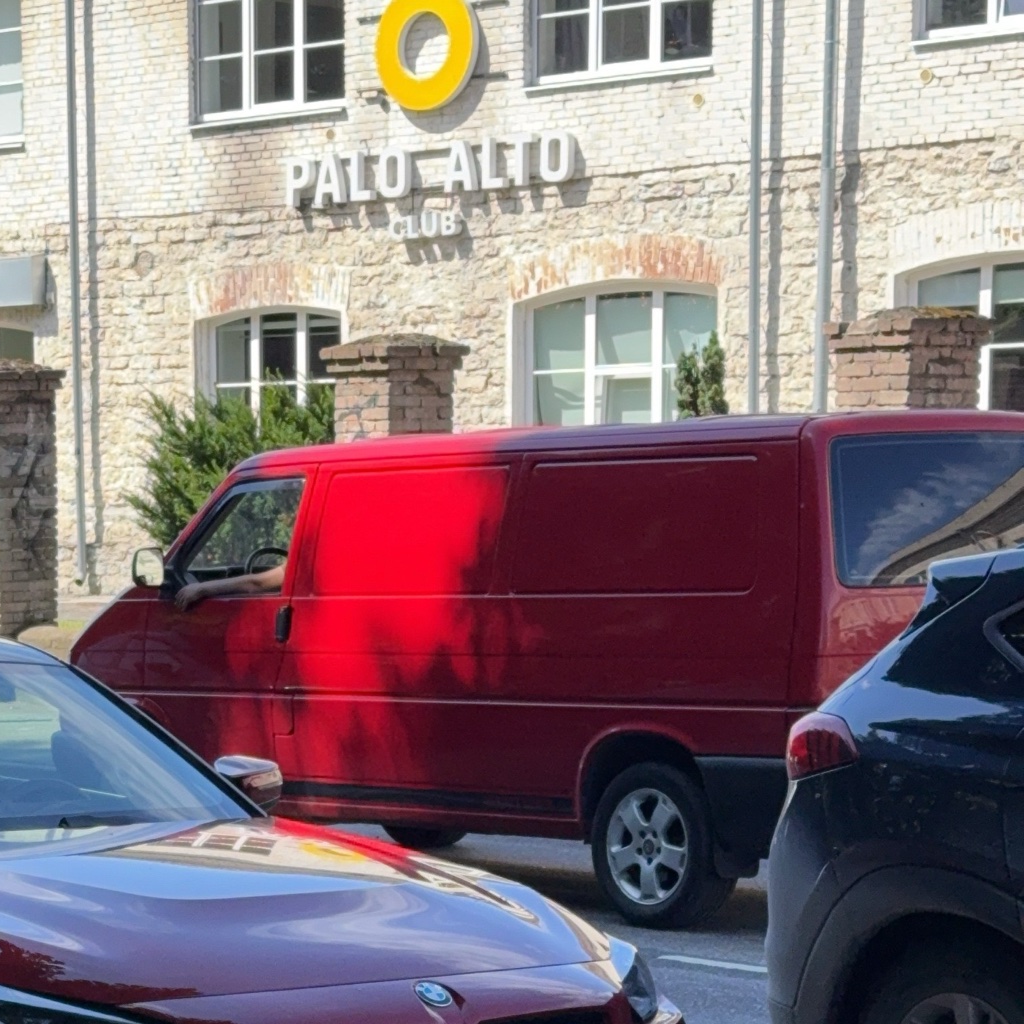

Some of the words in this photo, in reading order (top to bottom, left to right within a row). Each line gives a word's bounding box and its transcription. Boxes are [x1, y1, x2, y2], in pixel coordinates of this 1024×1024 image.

[285, 150, 412, 209] PALO
[443, 130, 576, 193] ALTO
[388, 212, 463, 240] CLUB
